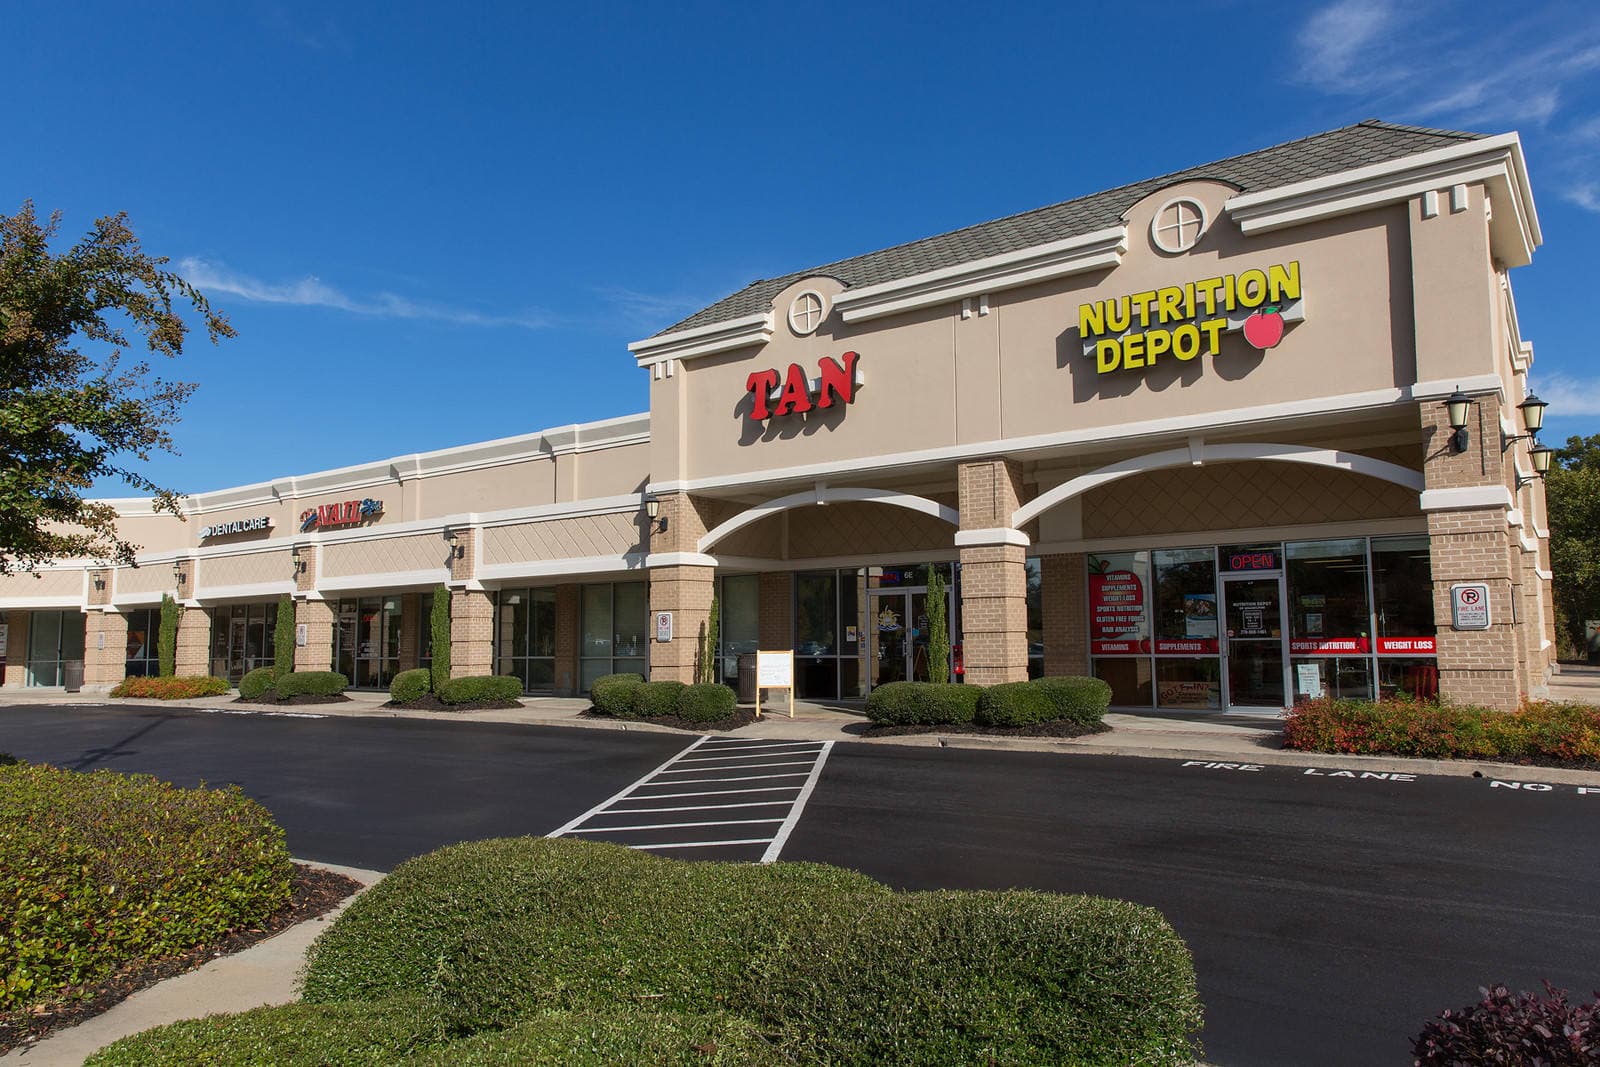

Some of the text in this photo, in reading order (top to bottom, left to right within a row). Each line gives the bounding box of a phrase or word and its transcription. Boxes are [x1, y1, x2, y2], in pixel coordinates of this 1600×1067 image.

[1078, 260, 1302, 339] NUTRITION
[1096, 317, 1228, 375] DEPOT
[746, 350, 860, 420] TAN
[317, 500, 362, 526] NAIL
[212, 516, 268, 536] DENTAL CARE
[1231, 553, 1273, 570] OPEN
[1101, 584, 1137, 592] SUPPLEMENTS
[1101, 643, 1129, 651] VITAMINS
[1291, 641, 1356, 650] SPORTS NUTRITION
[1383, 641, 1433, 650] WEIGHT LOSS
[1181, 761, 1553, 791] FIRE LANE NO
